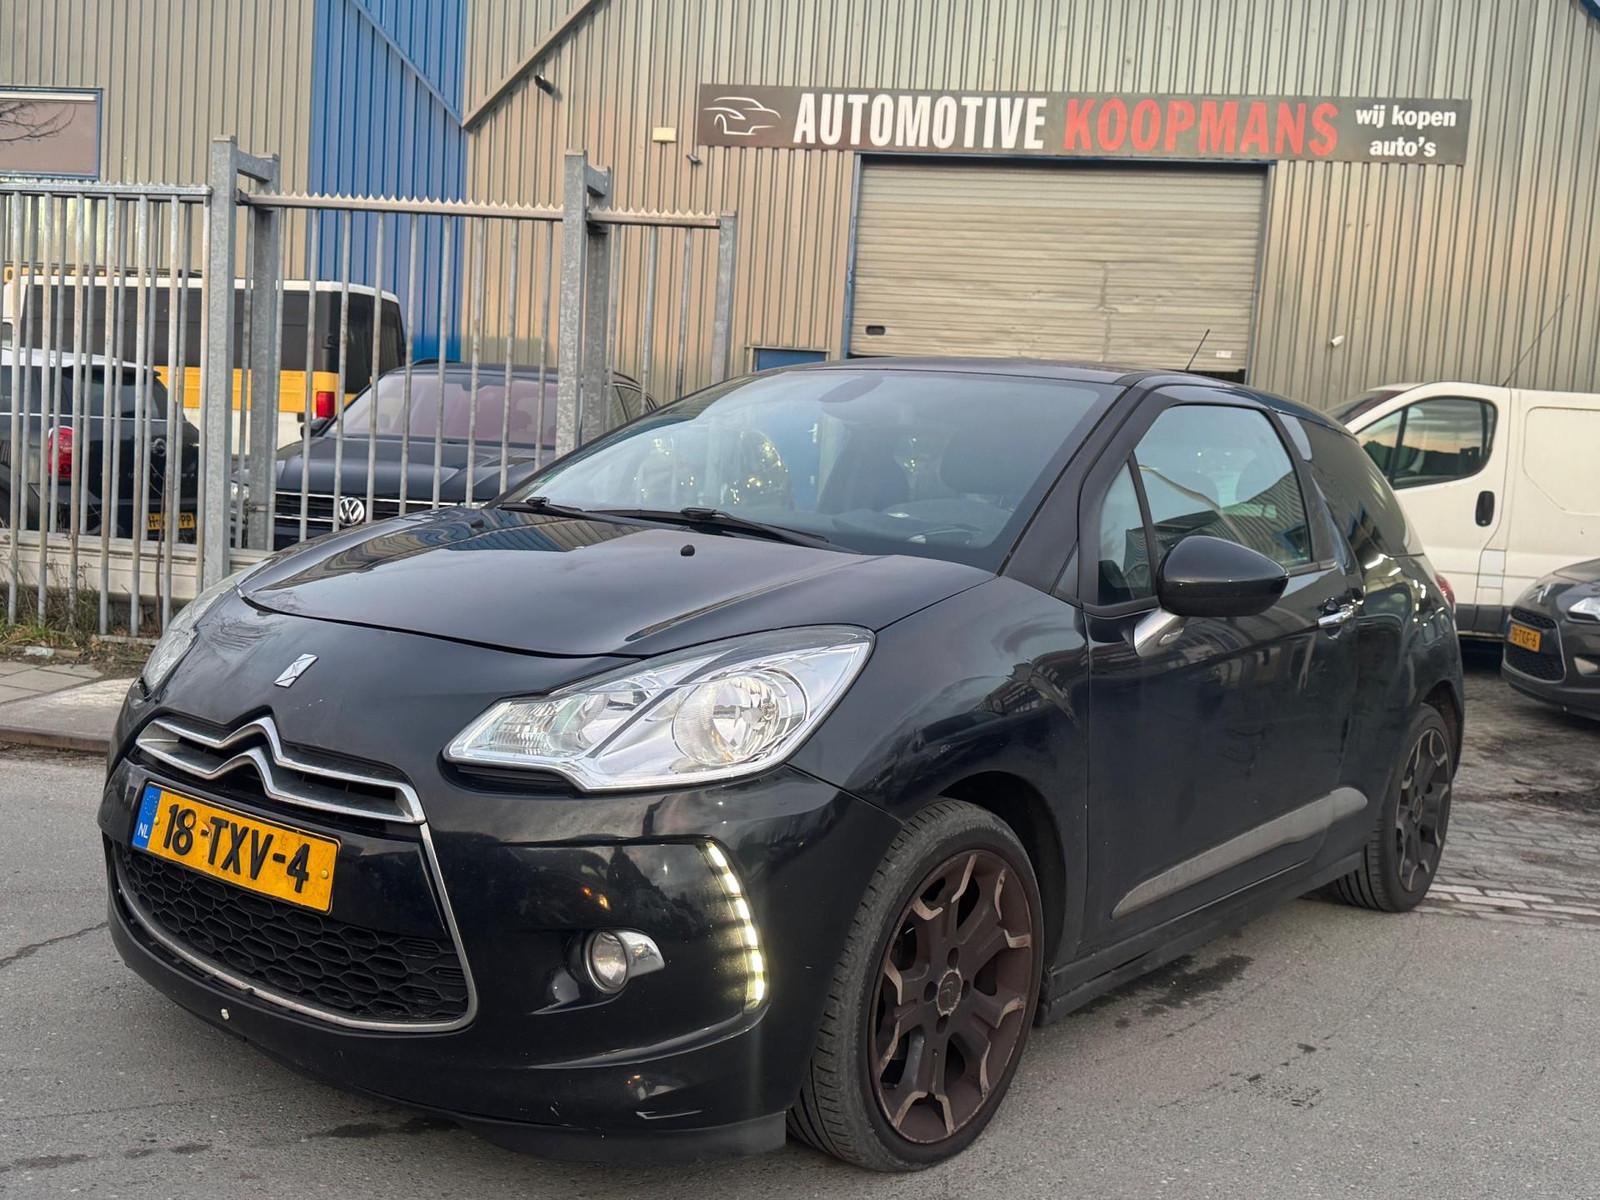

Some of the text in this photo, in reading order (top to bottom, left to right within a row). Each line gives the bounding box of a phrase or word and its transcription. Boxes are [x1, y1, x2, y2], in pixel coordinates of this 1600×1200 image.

[793, 93, 1338, 156] AUTOMOTIVE KOOPMANS
[1355, 104, 1457, 130] wij kopen
[1369, 136, 1437, 157] auto's
[137, 822, 149, 840] NL
[162, 803, 310, 893] 18-TXV-4
